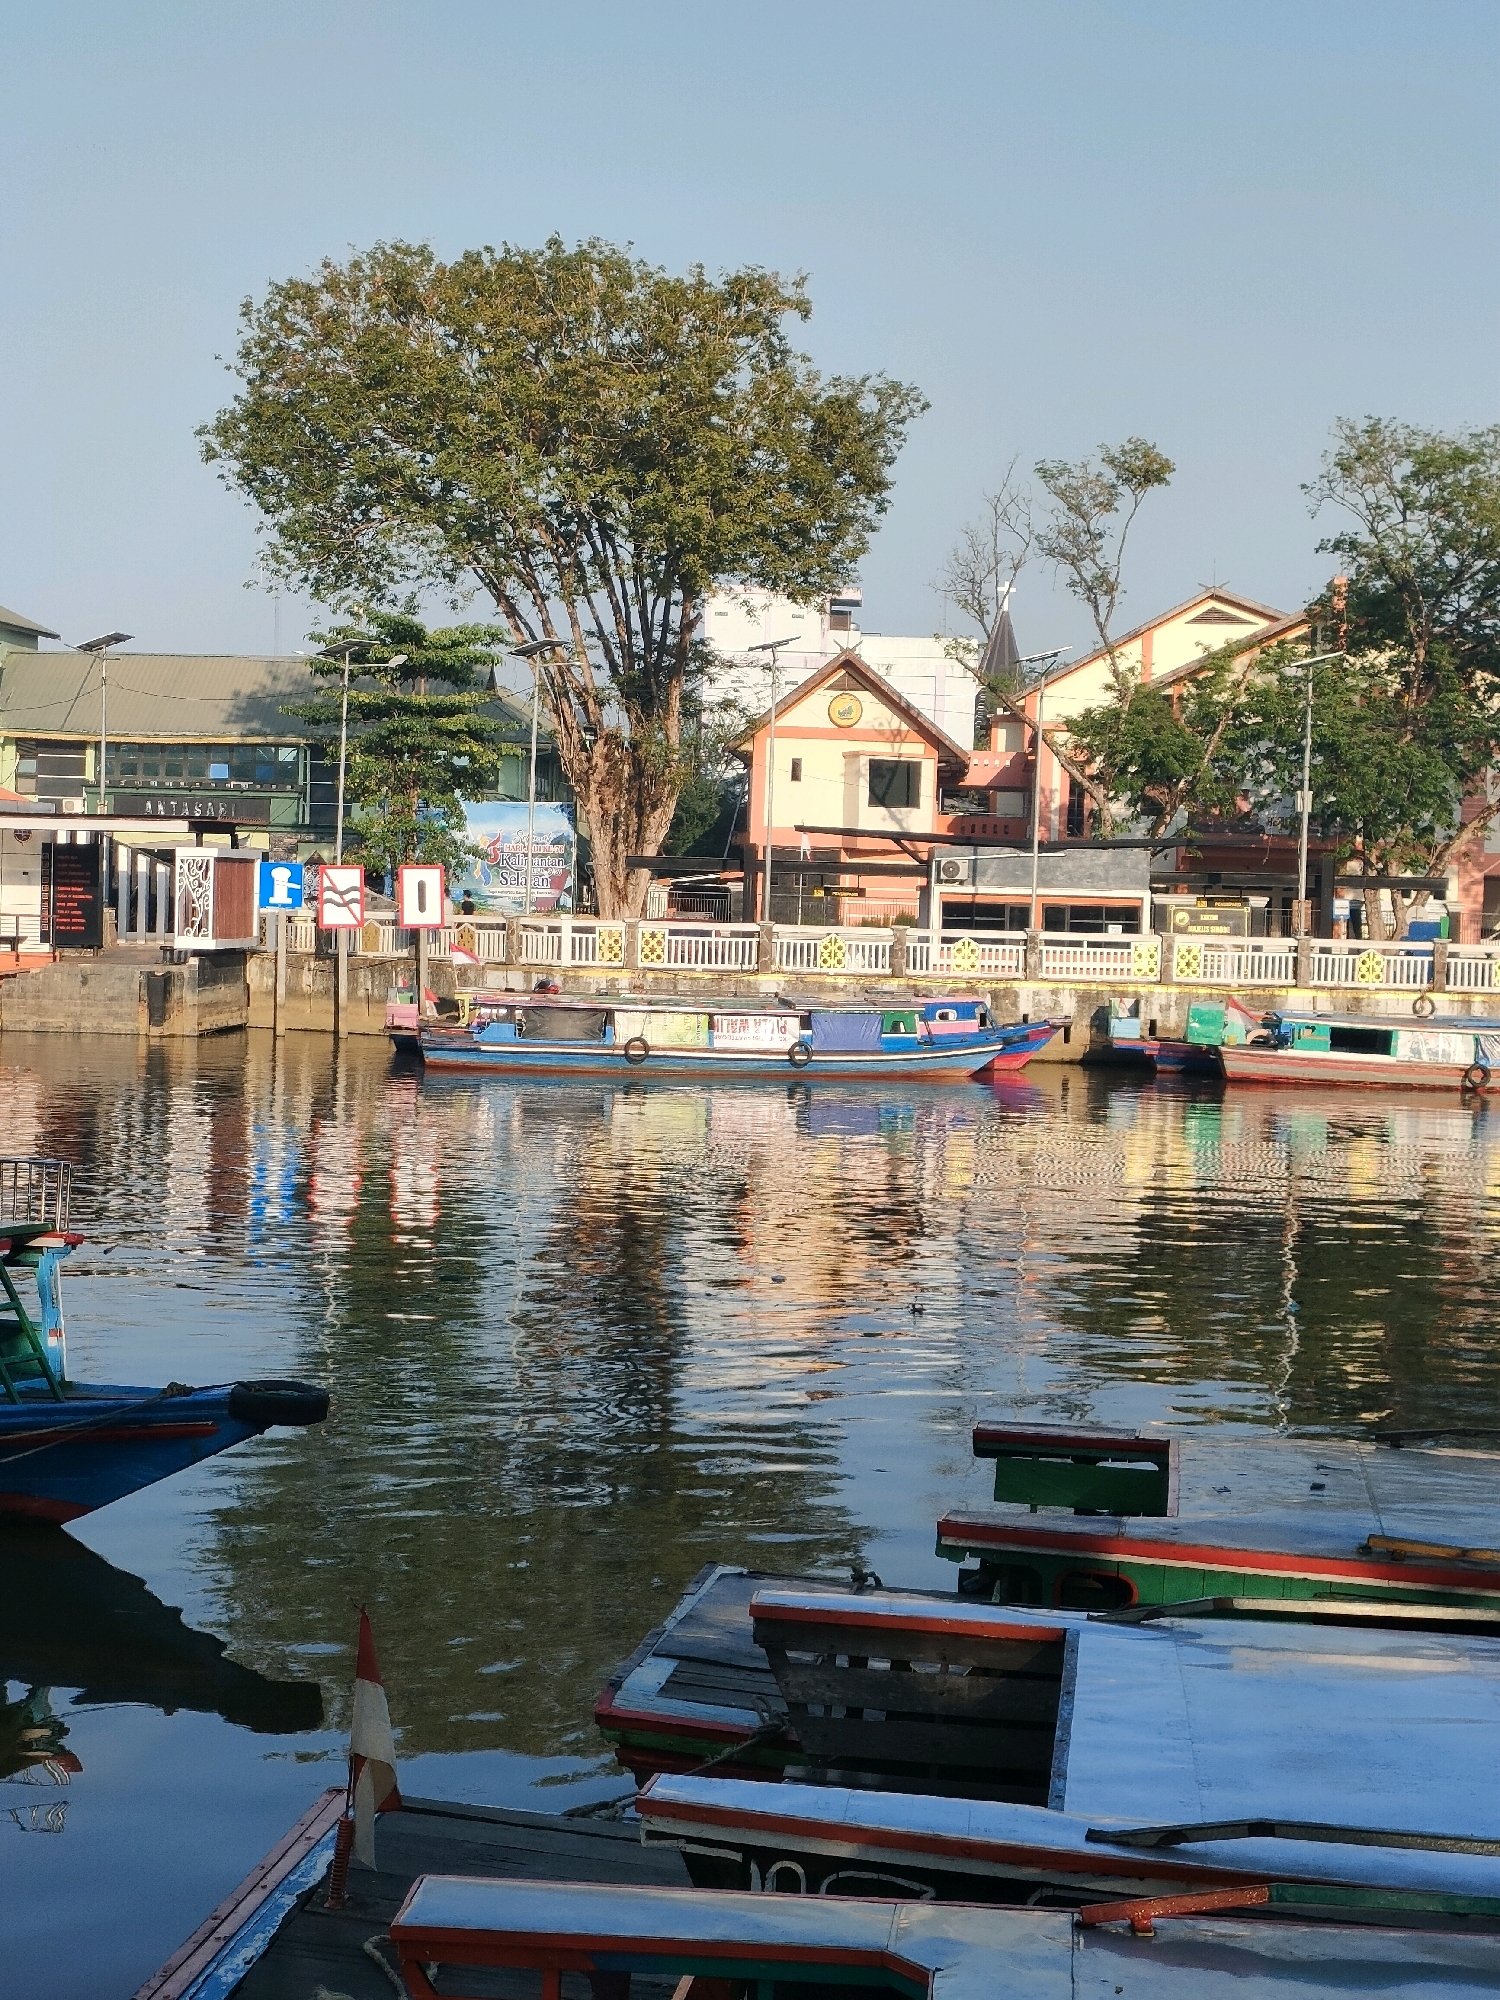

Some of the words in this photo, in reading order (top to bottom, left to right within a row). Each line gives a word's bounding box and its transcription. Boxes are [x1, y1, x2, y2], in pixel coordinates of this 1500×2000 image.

[144, 800, 236, 817] ANTASARI
[505, 844, 523, 852] HARI
[523, 844, 541, 853] JDI
[500, 871, 550, 887] Selaan
